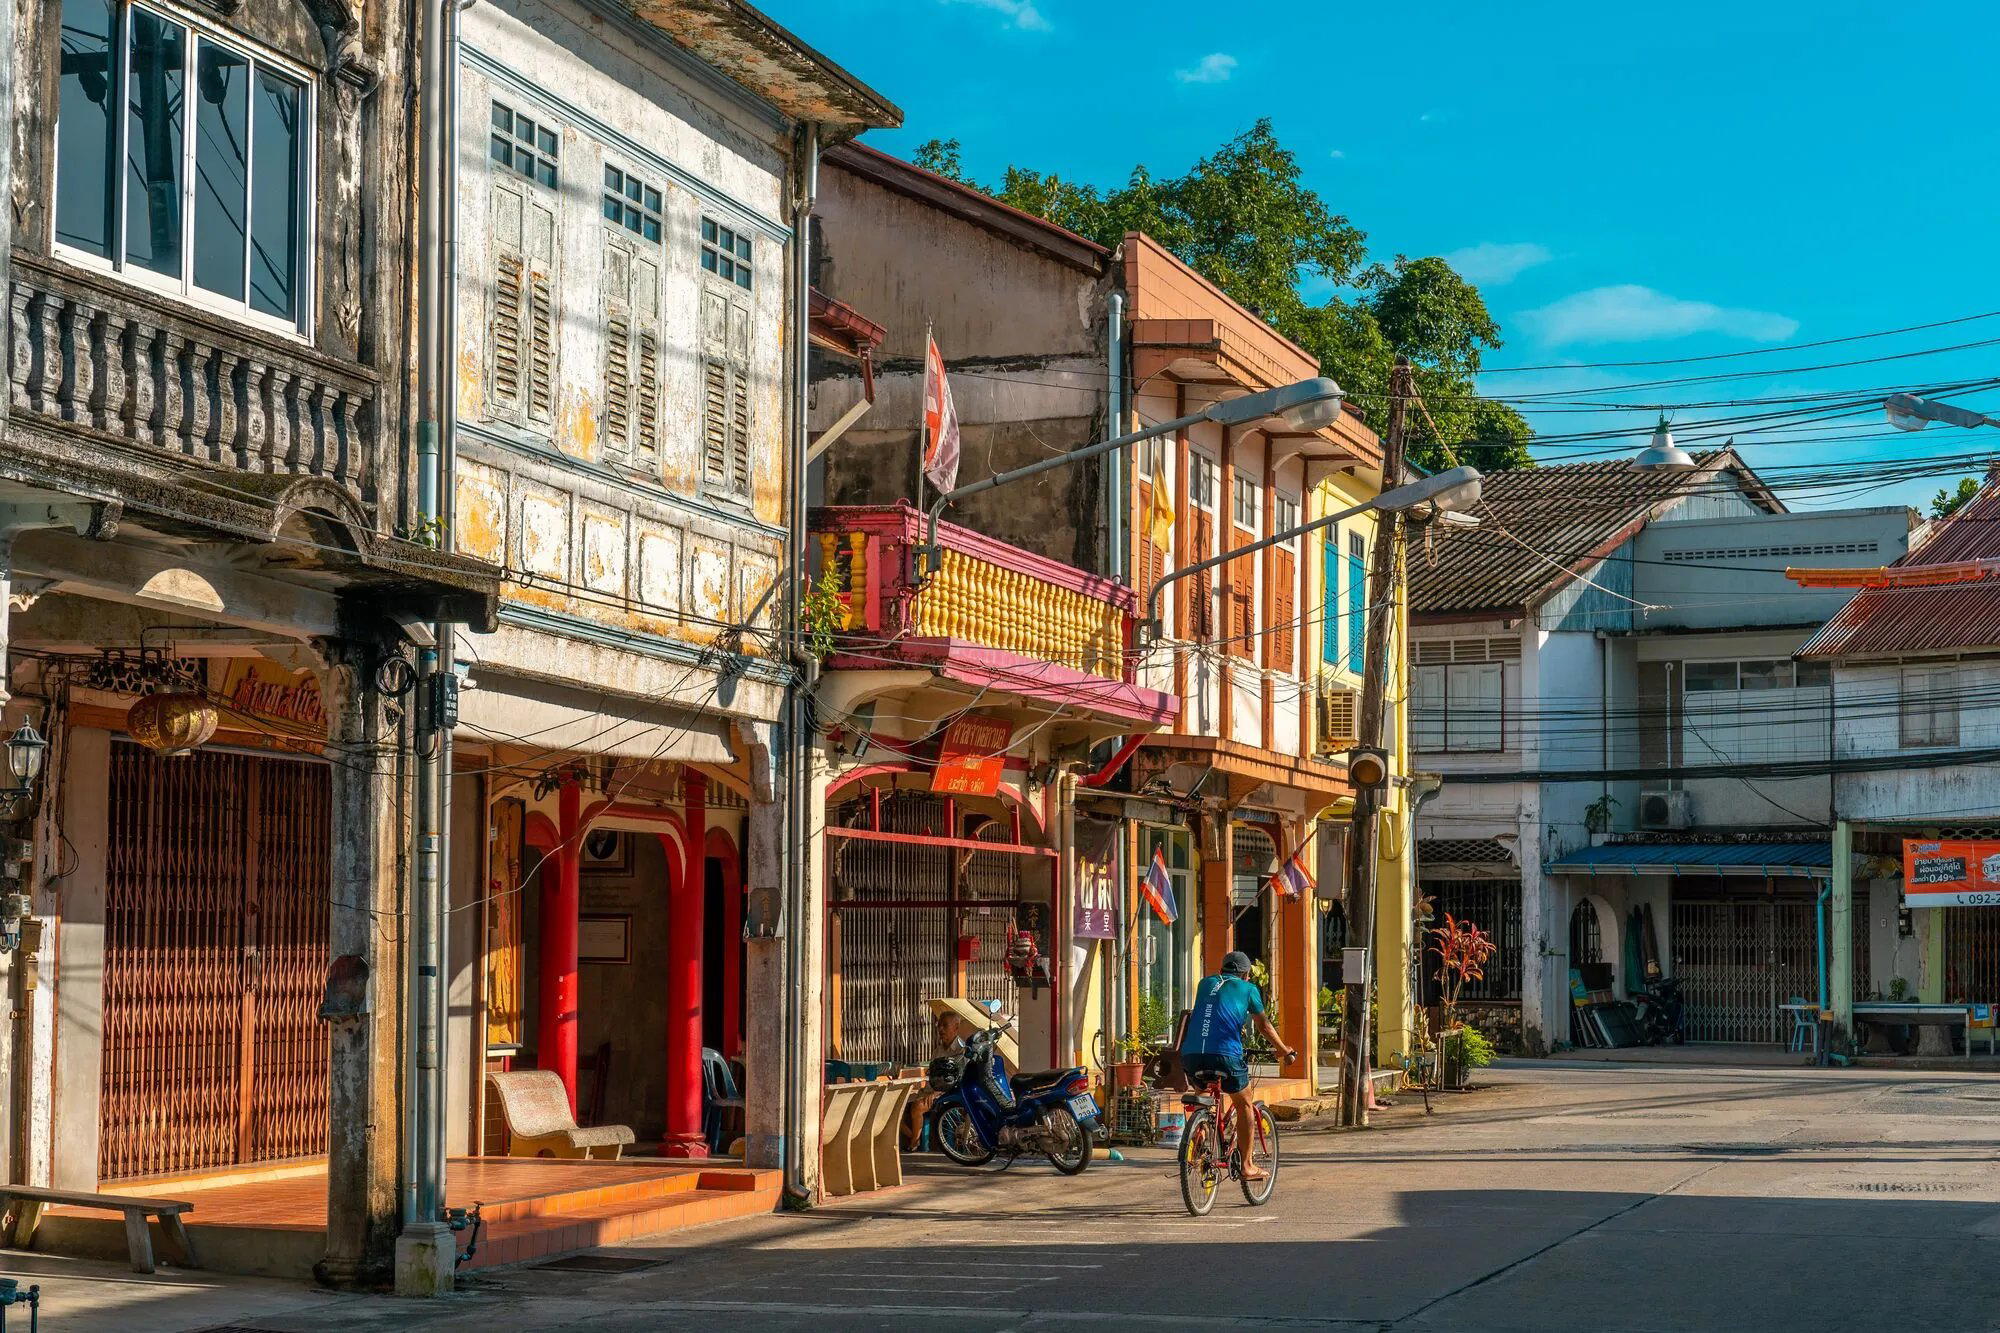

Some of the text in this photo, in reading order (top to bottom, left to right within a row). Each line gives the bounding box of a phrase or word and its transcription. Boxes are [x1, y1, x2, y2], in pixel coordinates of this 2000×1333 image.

[1929, 874, 1954, 883] 0.49%
[1201, 1003, 1213, 1037] RUN 2020
